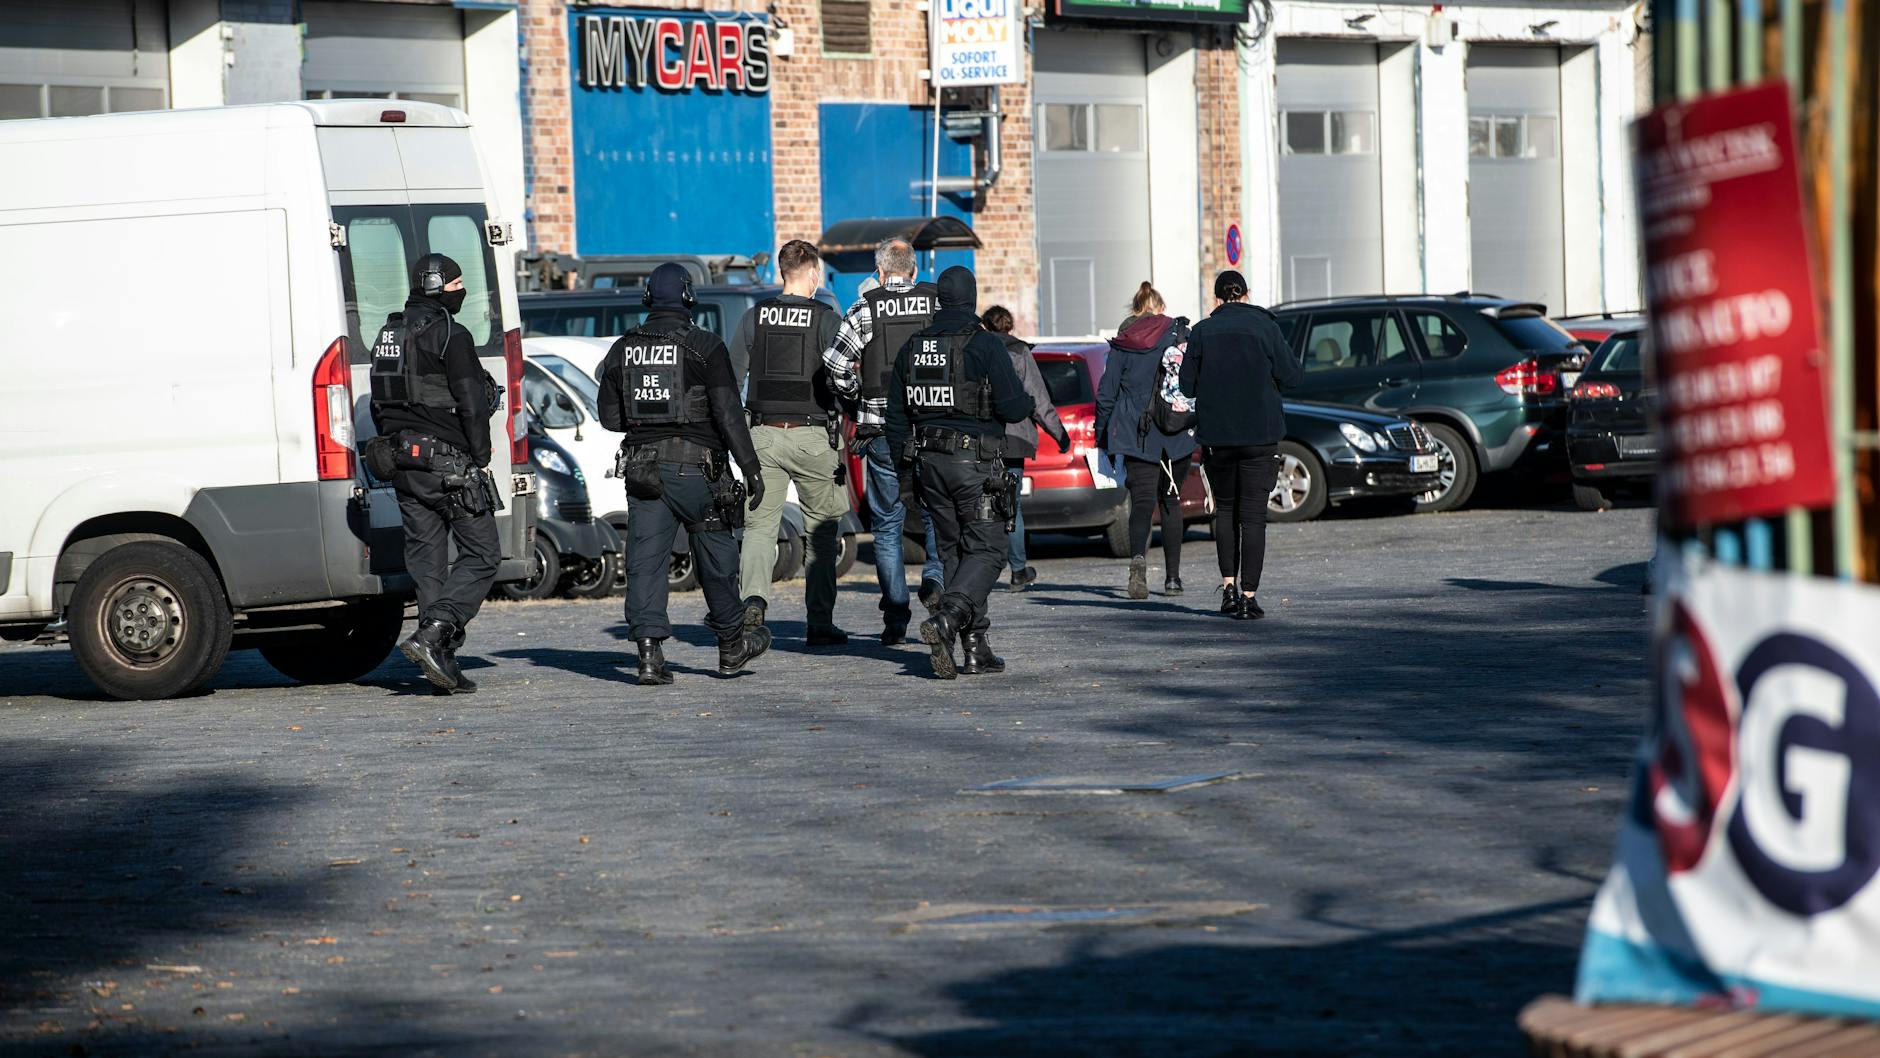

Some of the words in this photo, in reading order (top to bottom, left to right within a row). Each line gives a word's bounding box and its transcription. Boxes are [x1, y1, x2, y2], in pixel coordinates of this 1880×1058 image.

[941, 20, 1009, 43] MOLY
[951, 50, 997, 65] SOFORT
[876, 297, 931, 318] POLIZEI
[759, 306, 812, 327] POLIZEI
[382, 331, 394, 343] BE
[375, 345, 400, 358] 24113
[922, 341, 937, 353] BE
[625, 345, 678, 366] POLIZEI
[914, 354, 946, 367] 24135
[642, 375, 659, 388] BE
[634, 388, 671, 401] 24134
[906, 386, 955, 407] POLIZEI
